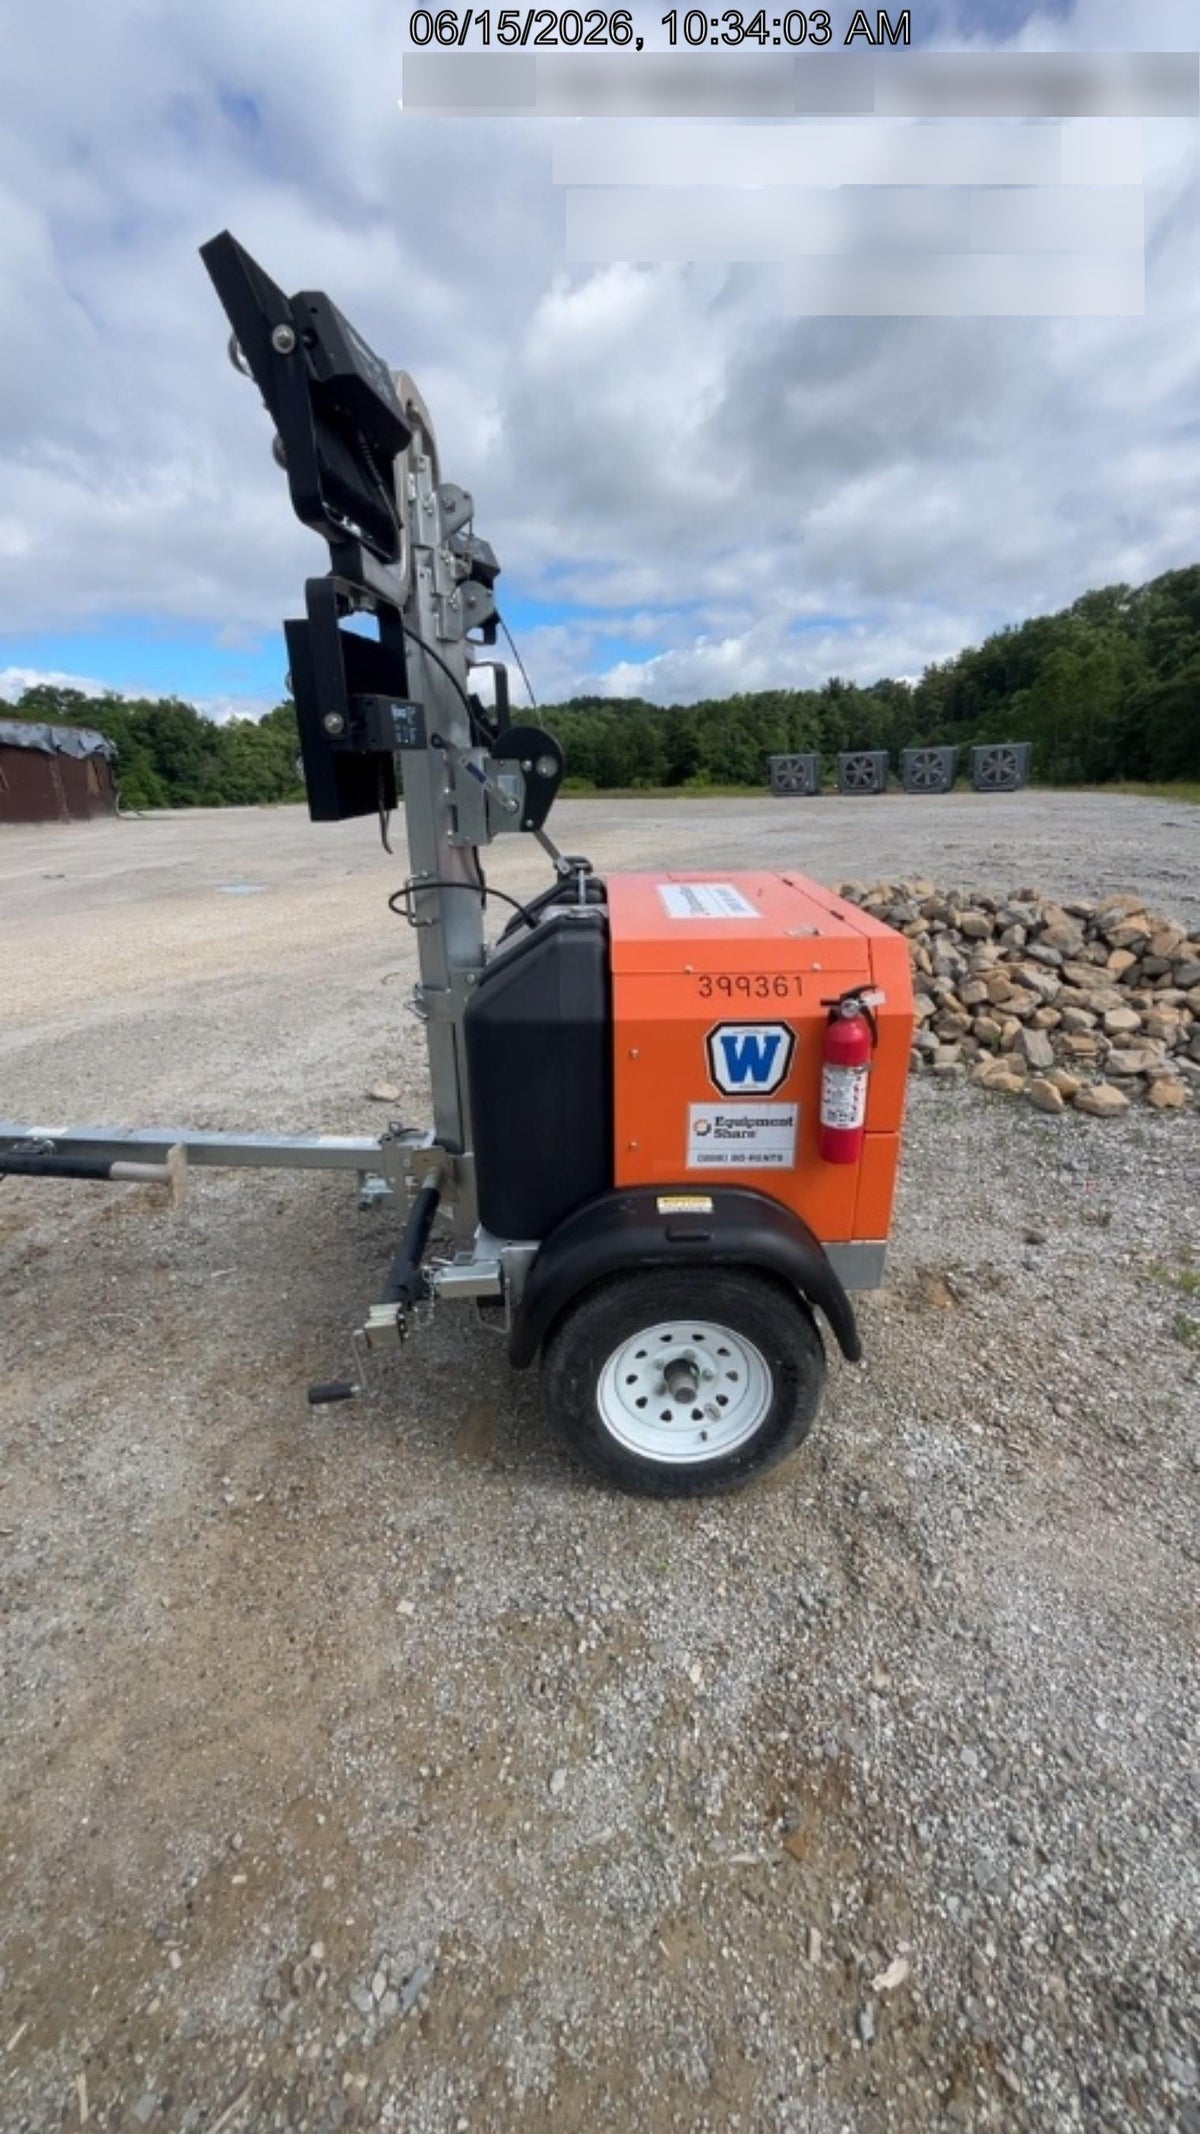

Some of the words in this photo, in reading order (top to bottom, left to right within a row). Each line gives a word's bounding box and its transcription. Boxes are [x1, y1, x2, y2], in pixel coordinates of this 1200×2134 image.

[699, 976, 802, 998] 399361
[720, 1035, 781, 1083] W
[715, 1116, 793, 1128] Equipment
[714, 1128, 755, 1138] Share
